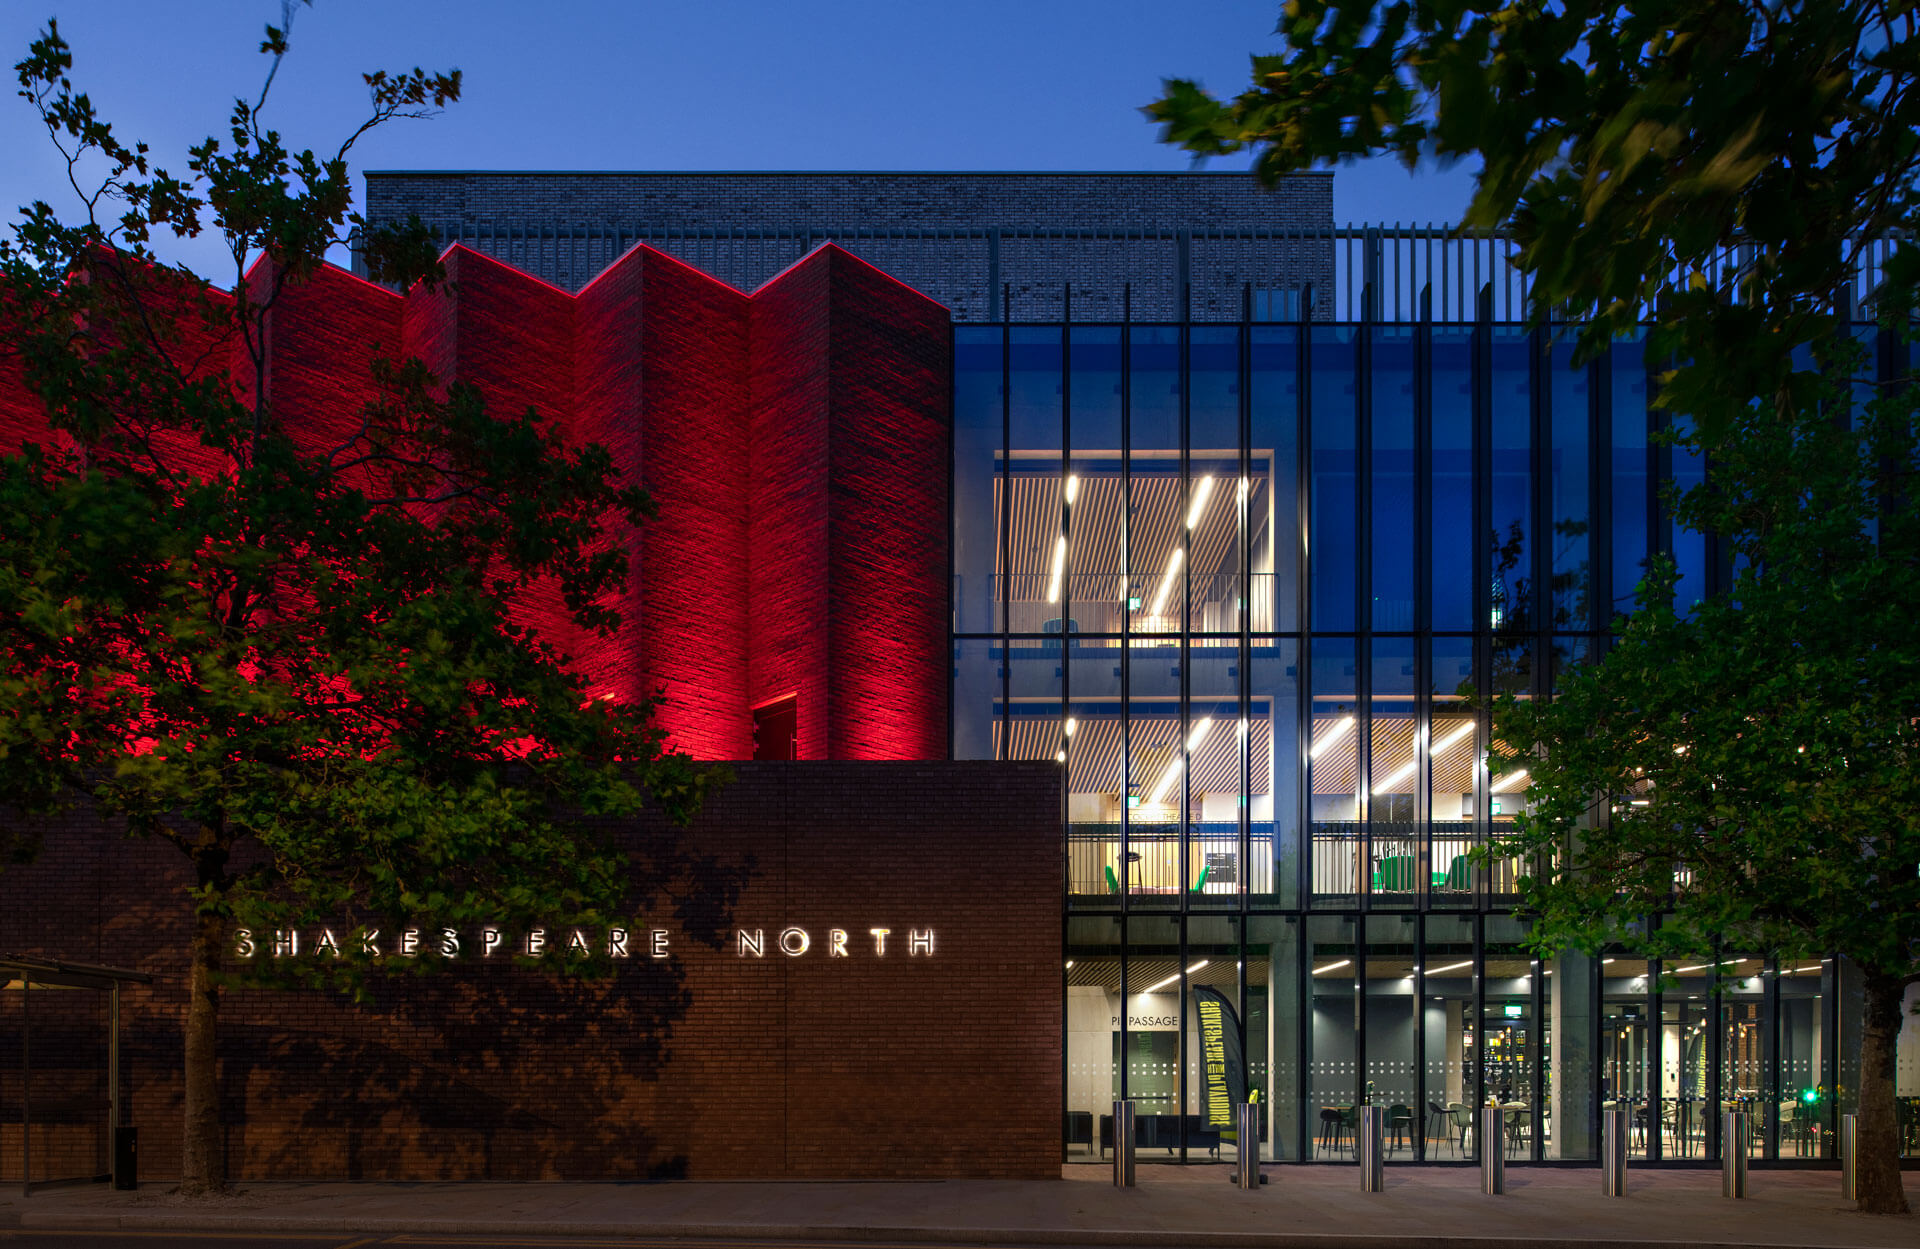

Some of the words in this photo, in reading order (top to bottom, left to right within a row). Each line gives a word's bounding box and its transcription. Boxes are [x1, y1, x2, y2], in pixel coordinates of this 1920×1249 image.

[234, 928, 669, 957] SHAKESPEARE
[738, 927, 934, 957] NORTH
[1111, 1016, 1121, 1026] PI
[1129, 1016, 1178, 1026] PASSAGE
